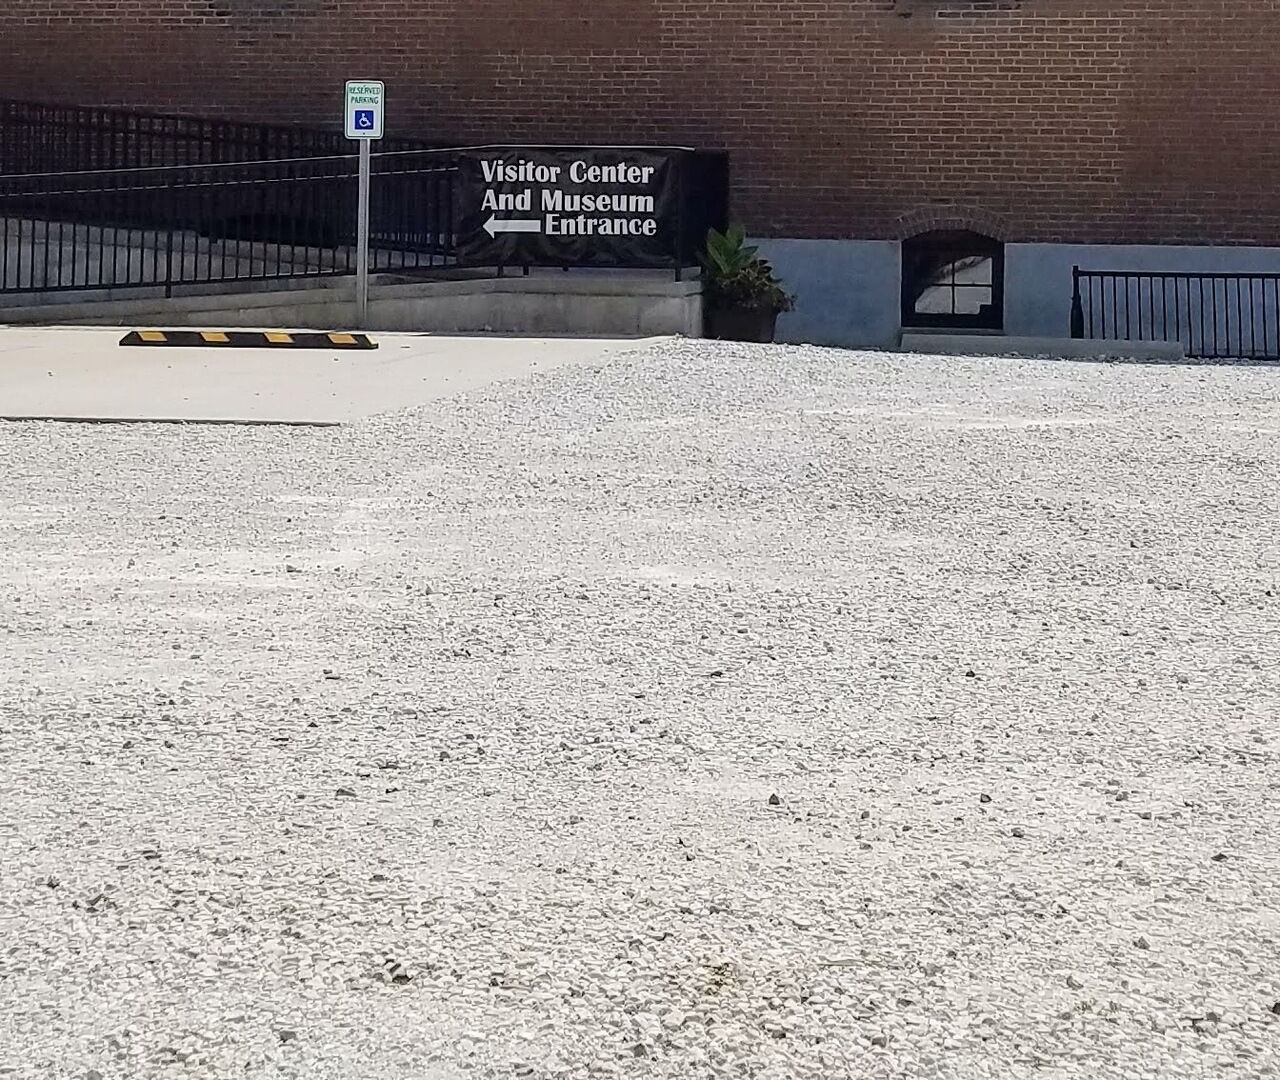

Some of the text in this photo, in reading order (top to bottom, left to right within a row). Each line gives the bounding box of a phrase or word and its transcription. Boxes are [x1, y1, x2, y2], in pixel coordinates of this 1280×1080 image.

[348, 86, 381, 95] RESERVED
[350, 96, 379, 104] PARKING
[480, 159, 655, 184] Visitor Center
[480, 188, 654, 213] And Museum
[544, 212, 657, 236] Entrance
